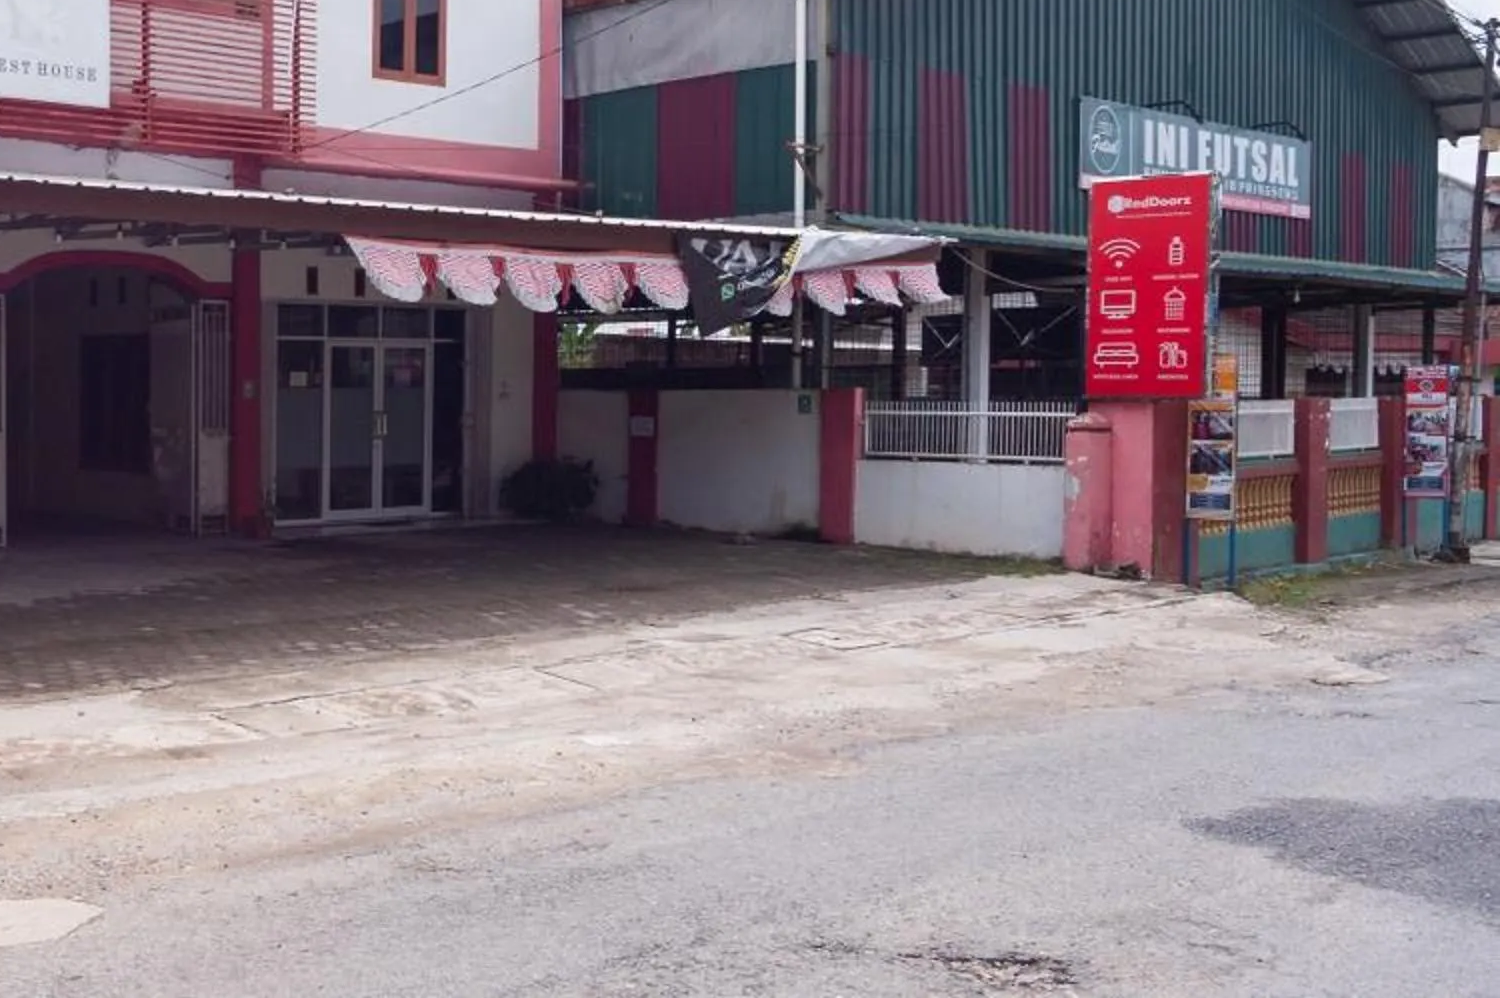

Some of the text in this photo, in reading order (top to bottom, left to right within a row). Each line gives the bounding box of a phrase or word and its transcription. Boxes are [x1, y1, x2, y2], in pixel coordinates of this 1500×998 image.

[37, 60, 98, 83] HOUSE
[1143, 119, 1300, 188] INI FUTSAL
